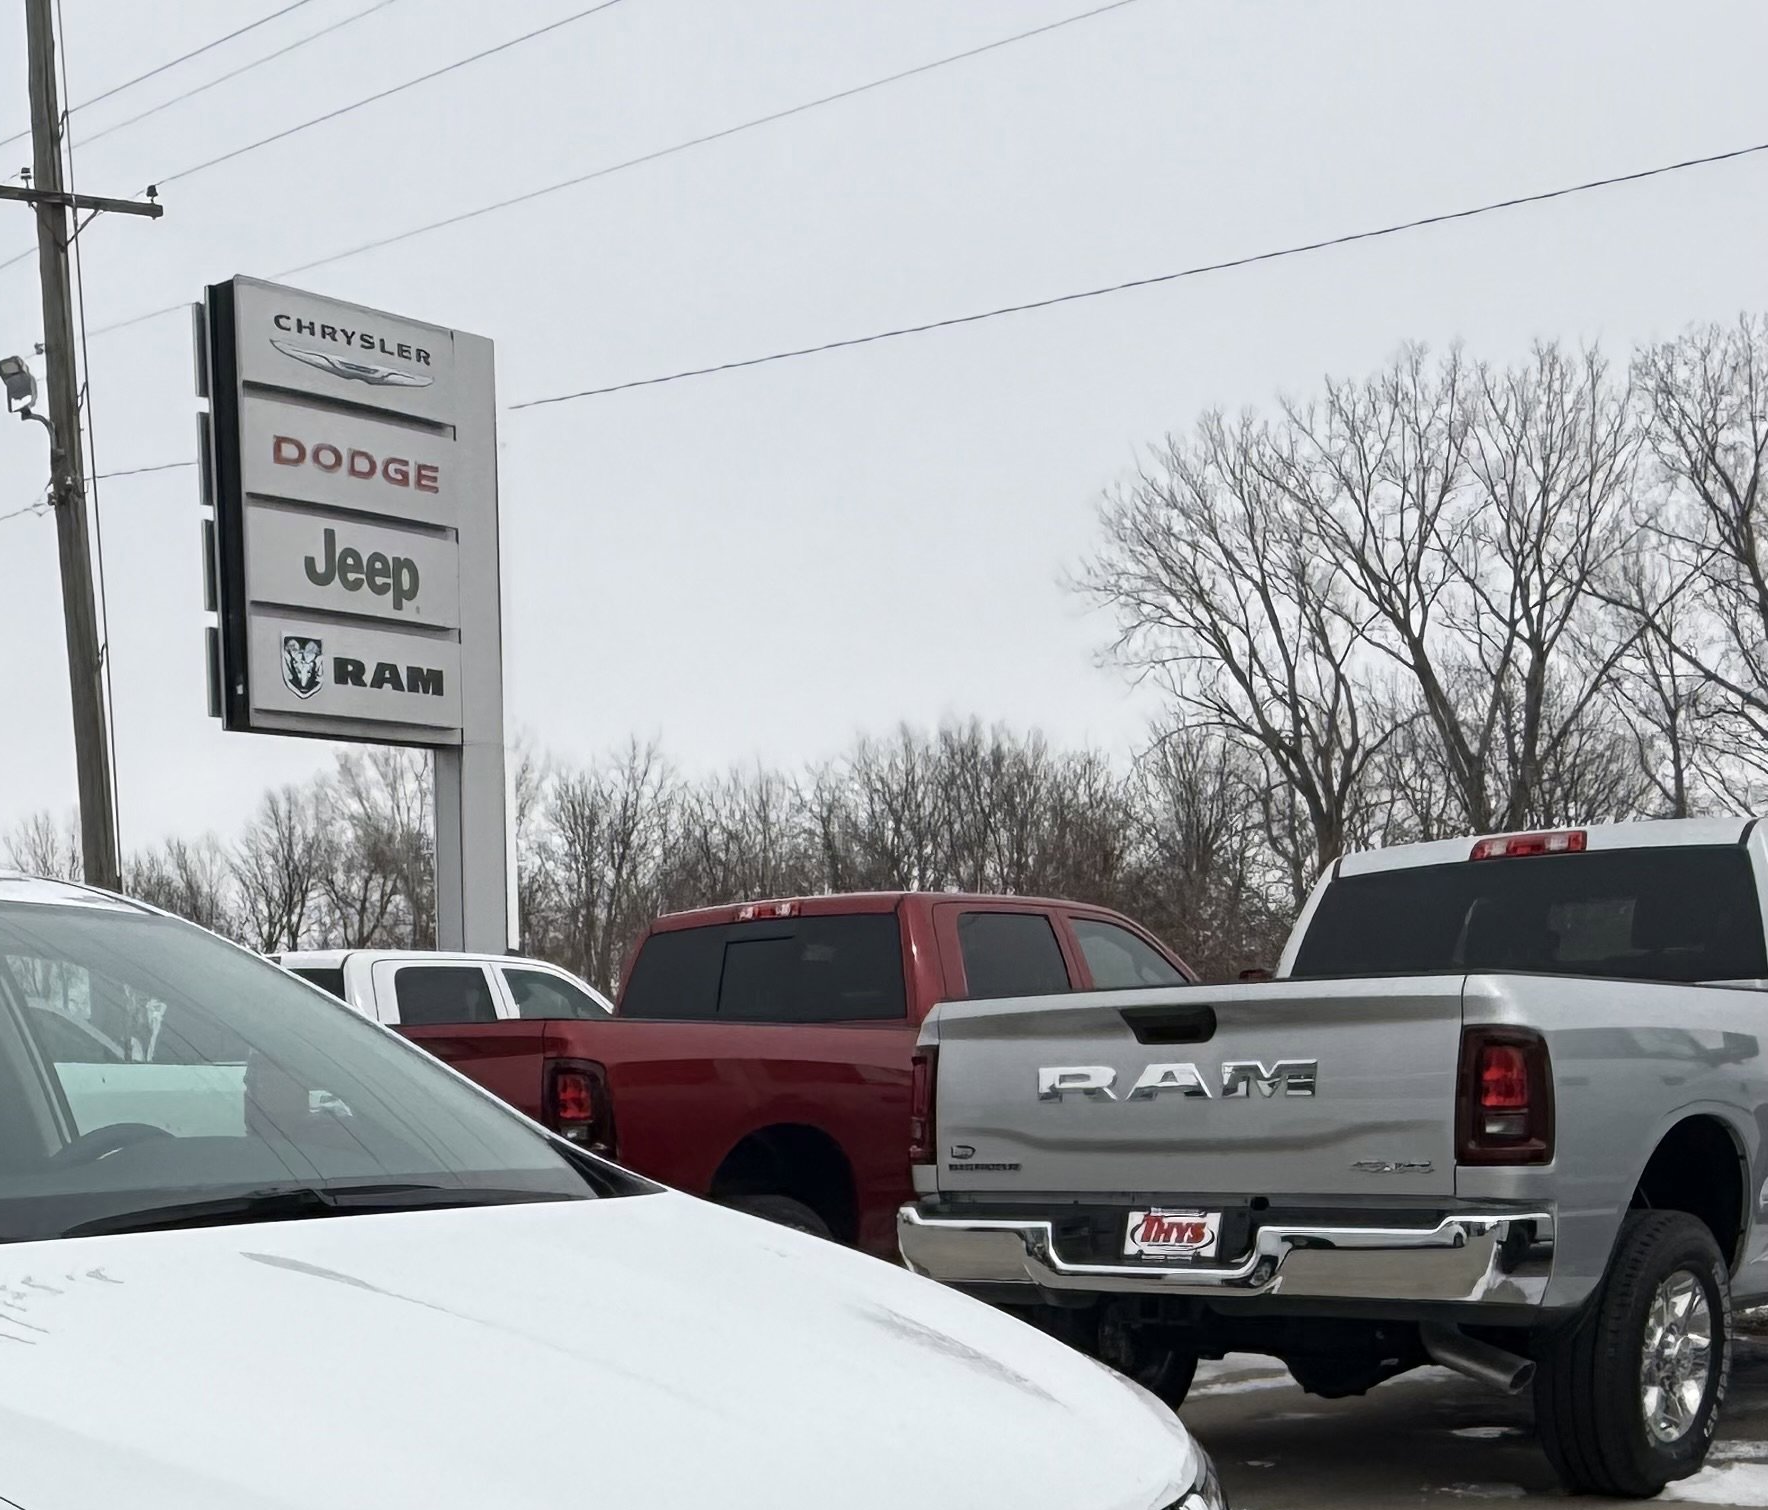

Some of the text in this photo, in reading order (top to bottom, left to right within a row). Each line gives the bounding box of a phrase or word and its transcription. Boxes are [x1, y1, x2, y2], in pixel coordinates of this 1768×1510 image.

[273, 314, 432, 366] CHRYSLER
[273, 436, 440, 494] DODGE
[304, 528, 420, 610] Jeep
[333, 657, 444, 696] RAM
[1037, 1059, 1319, 1101] RAM
[1140, 1213, 1207, 1243] THYS
